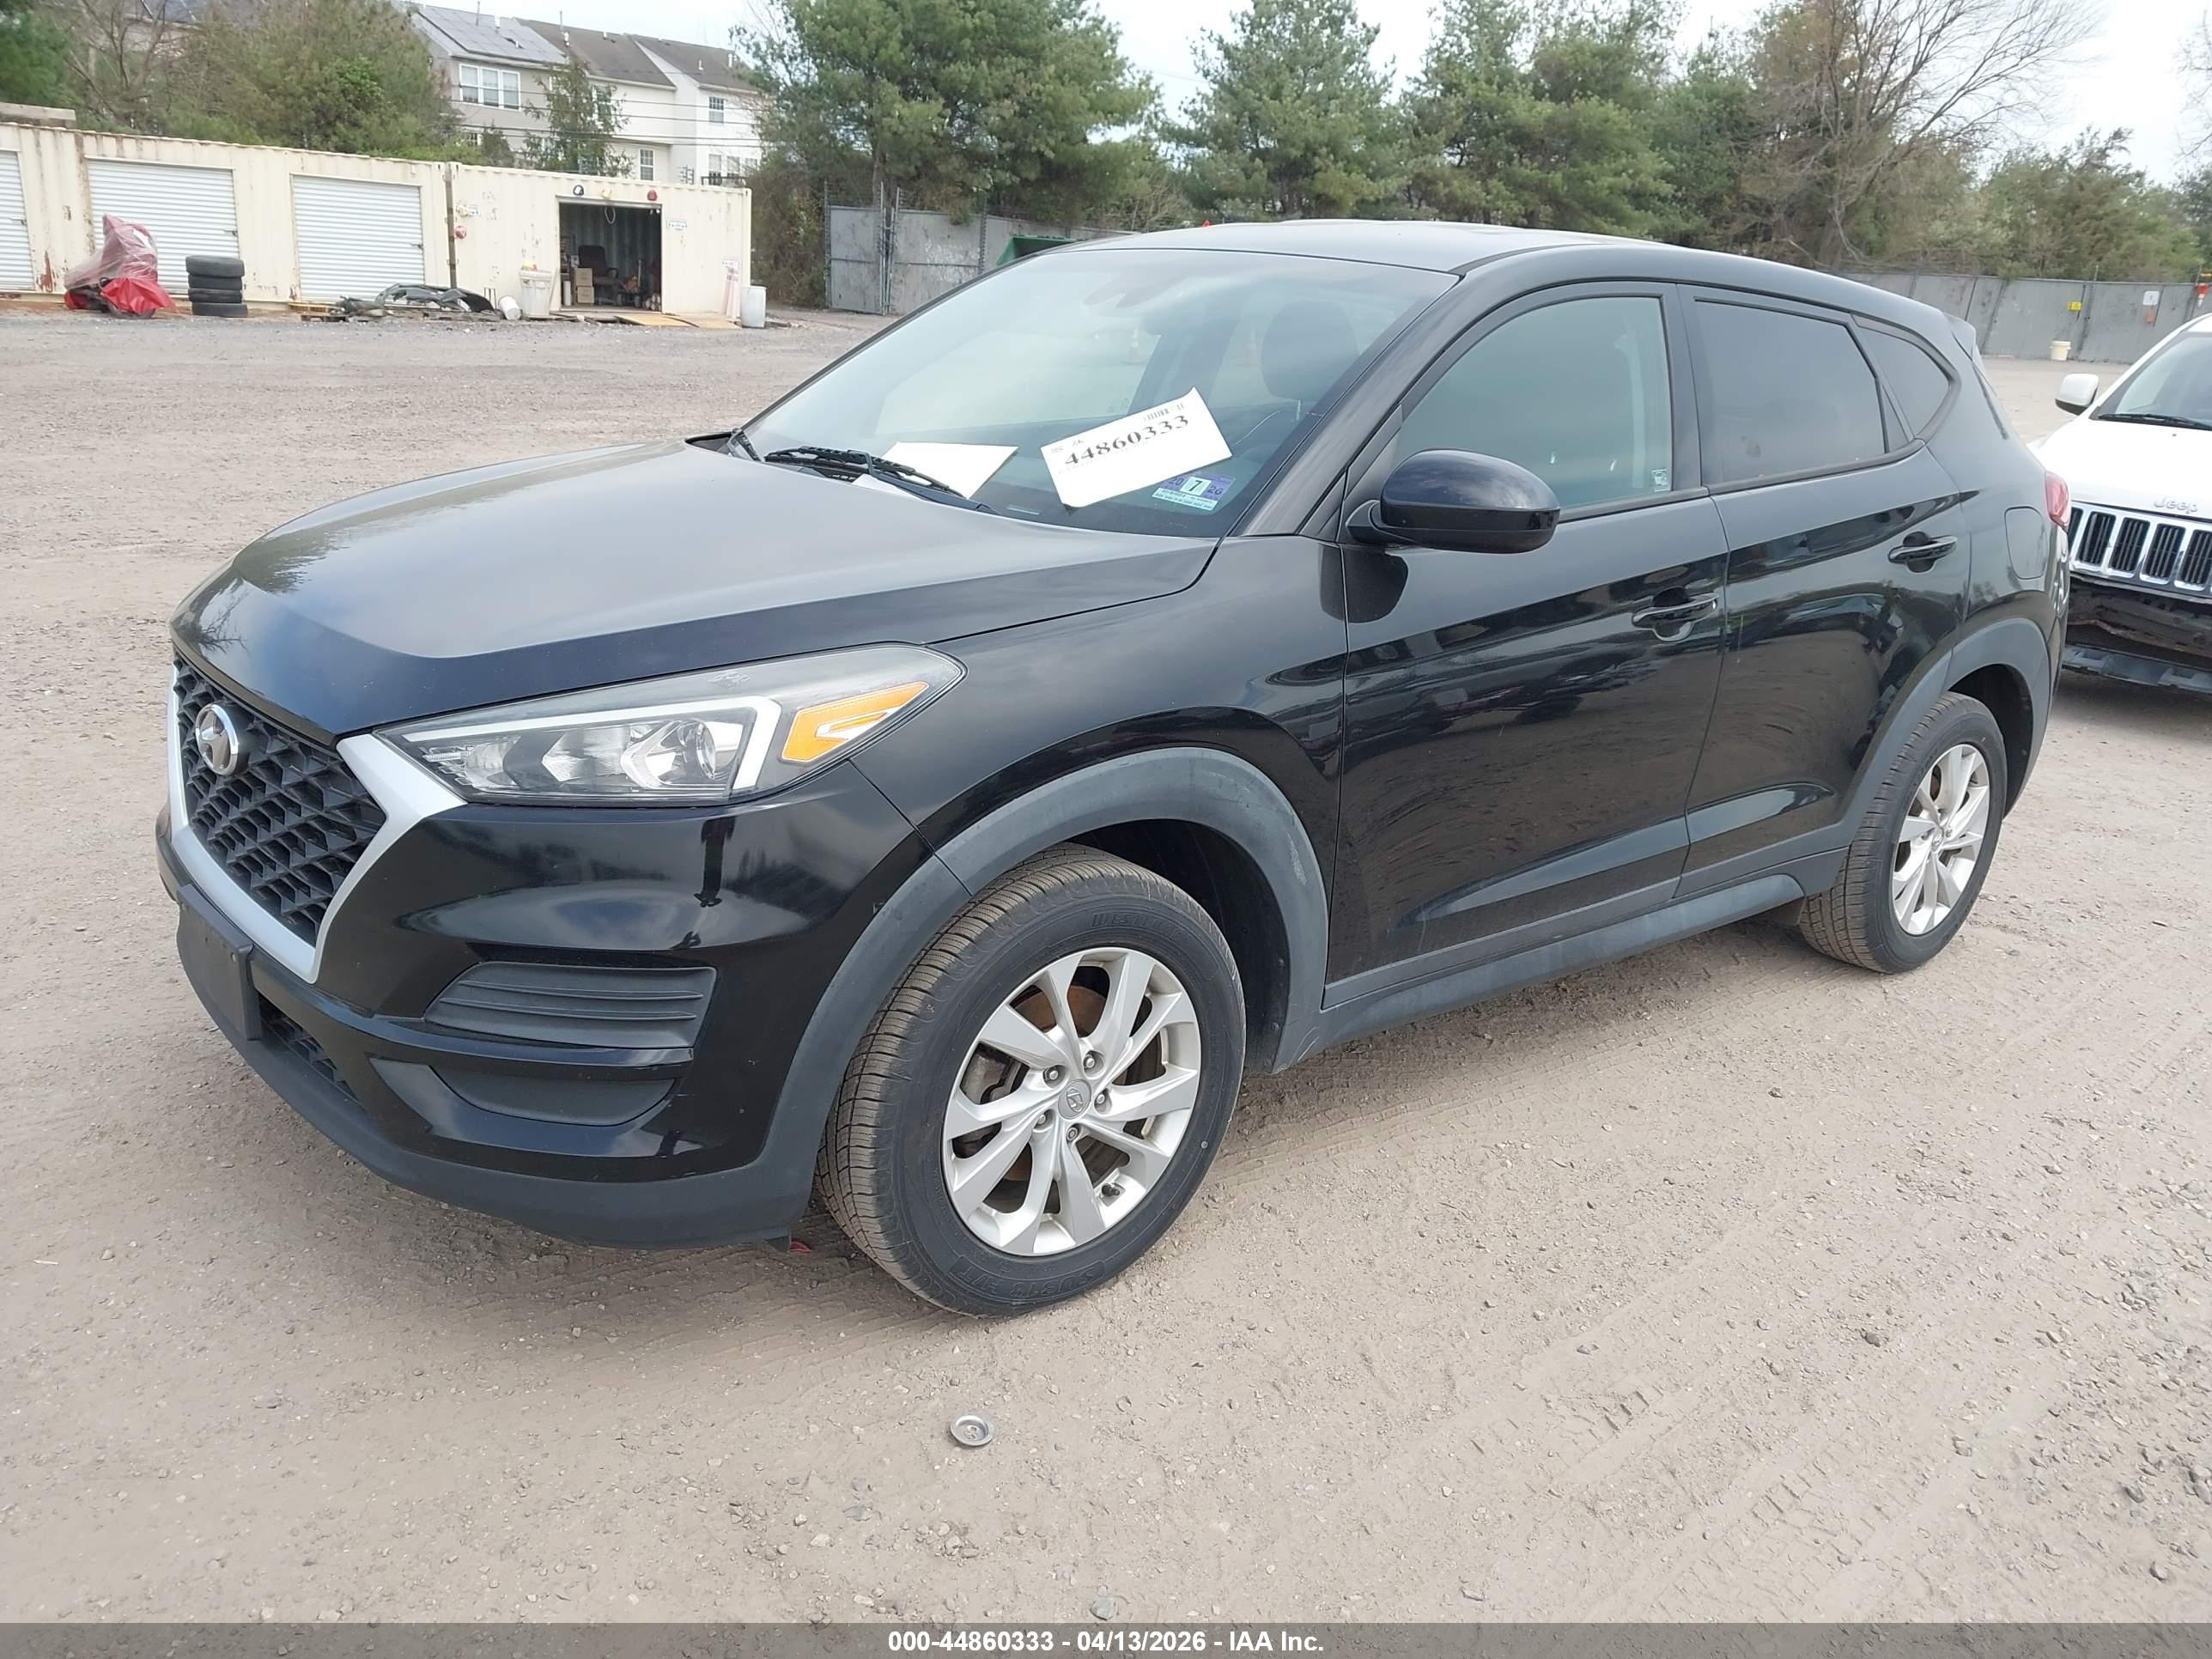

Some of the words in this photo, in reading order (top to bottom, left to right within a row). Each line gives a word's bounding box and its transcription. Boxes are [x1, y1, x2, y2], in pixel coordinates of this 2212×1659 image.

[1065, 415, 1189, 465] 44860333
[1188, 479, 1203, 492] 7
[2153, 495, 2199, 514] Jeep
[1091, 912, 1181, 941] WESTL
